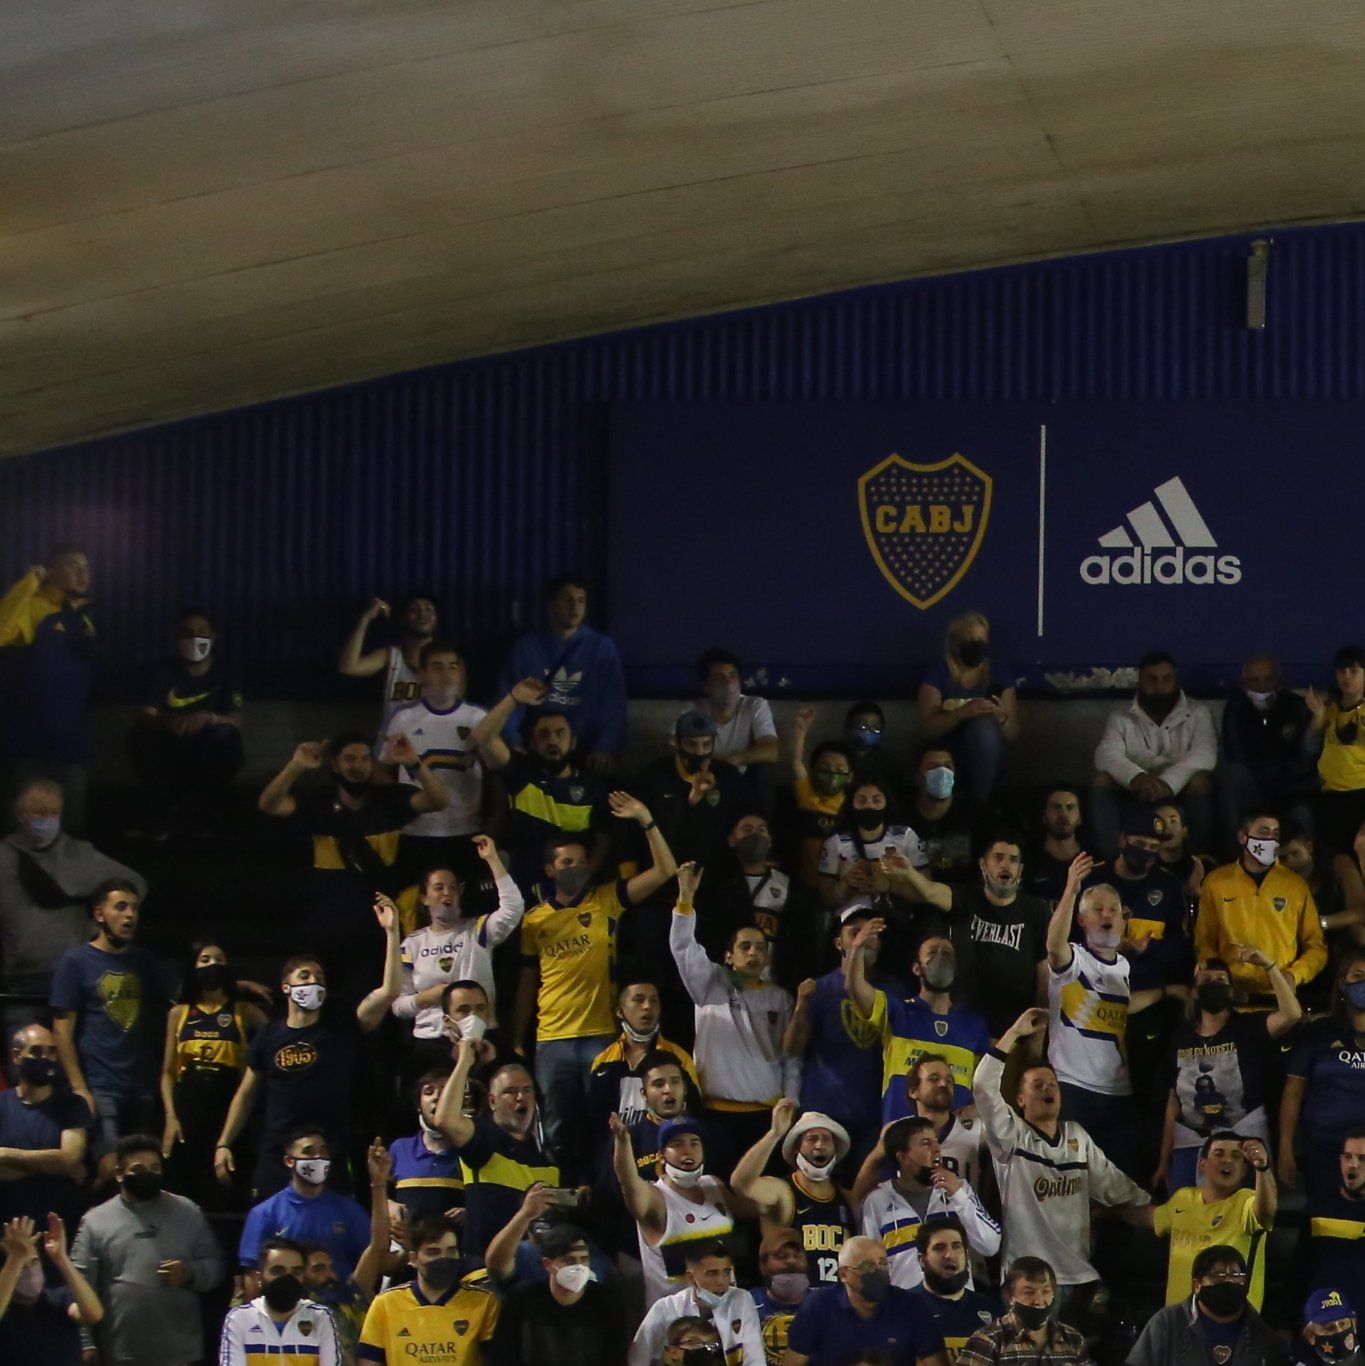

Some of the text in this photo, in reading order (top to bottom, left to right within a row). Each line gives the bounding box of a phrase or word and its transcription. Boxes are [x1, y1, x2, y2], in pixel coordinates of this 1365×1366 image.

[874, 504, 974, 533] CABJ
[1079, 546, 1242, 585] adidas
[545, 934, 592, 957] QATAR
[803, 1225, 844, 1252] BOC
[817, 1256, 839, 1282] 12
[405, 1342, 457, 1358] QATAR
